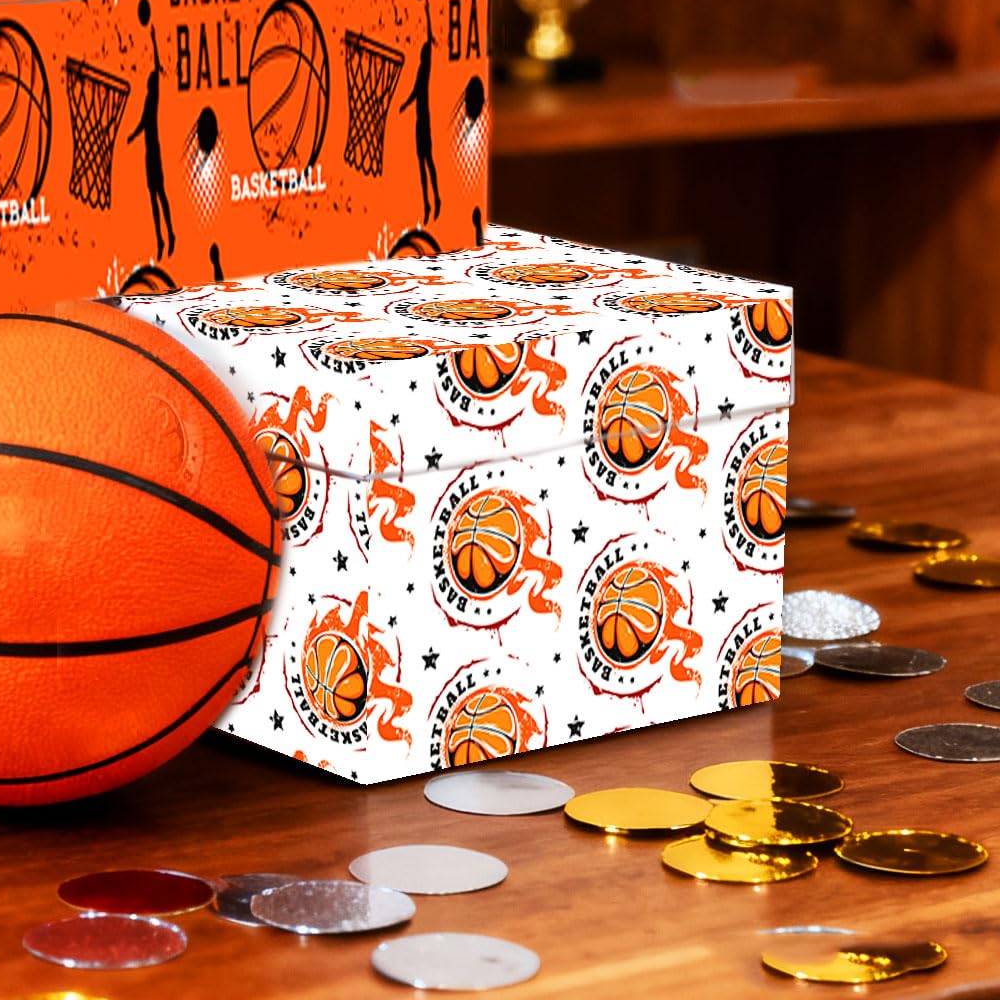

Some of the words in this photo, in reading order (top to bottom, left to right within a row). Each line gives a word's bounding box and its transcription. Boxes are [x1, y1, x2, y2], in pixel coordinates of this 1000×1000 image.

[177, 19, 250, 91] BALL
[231, 166, 326, 201] BASKETBALL
[436, 353, 471, 412] BASK
[730, 307, 762, 364] BASK
[583, 350, 629, 487] BASKETBALL
[724, 425, 768, 558] BASKETBALL
[433, 475, 479, 613] BASKETBALL
[579, 547, 624, 682] BASKETBALL
